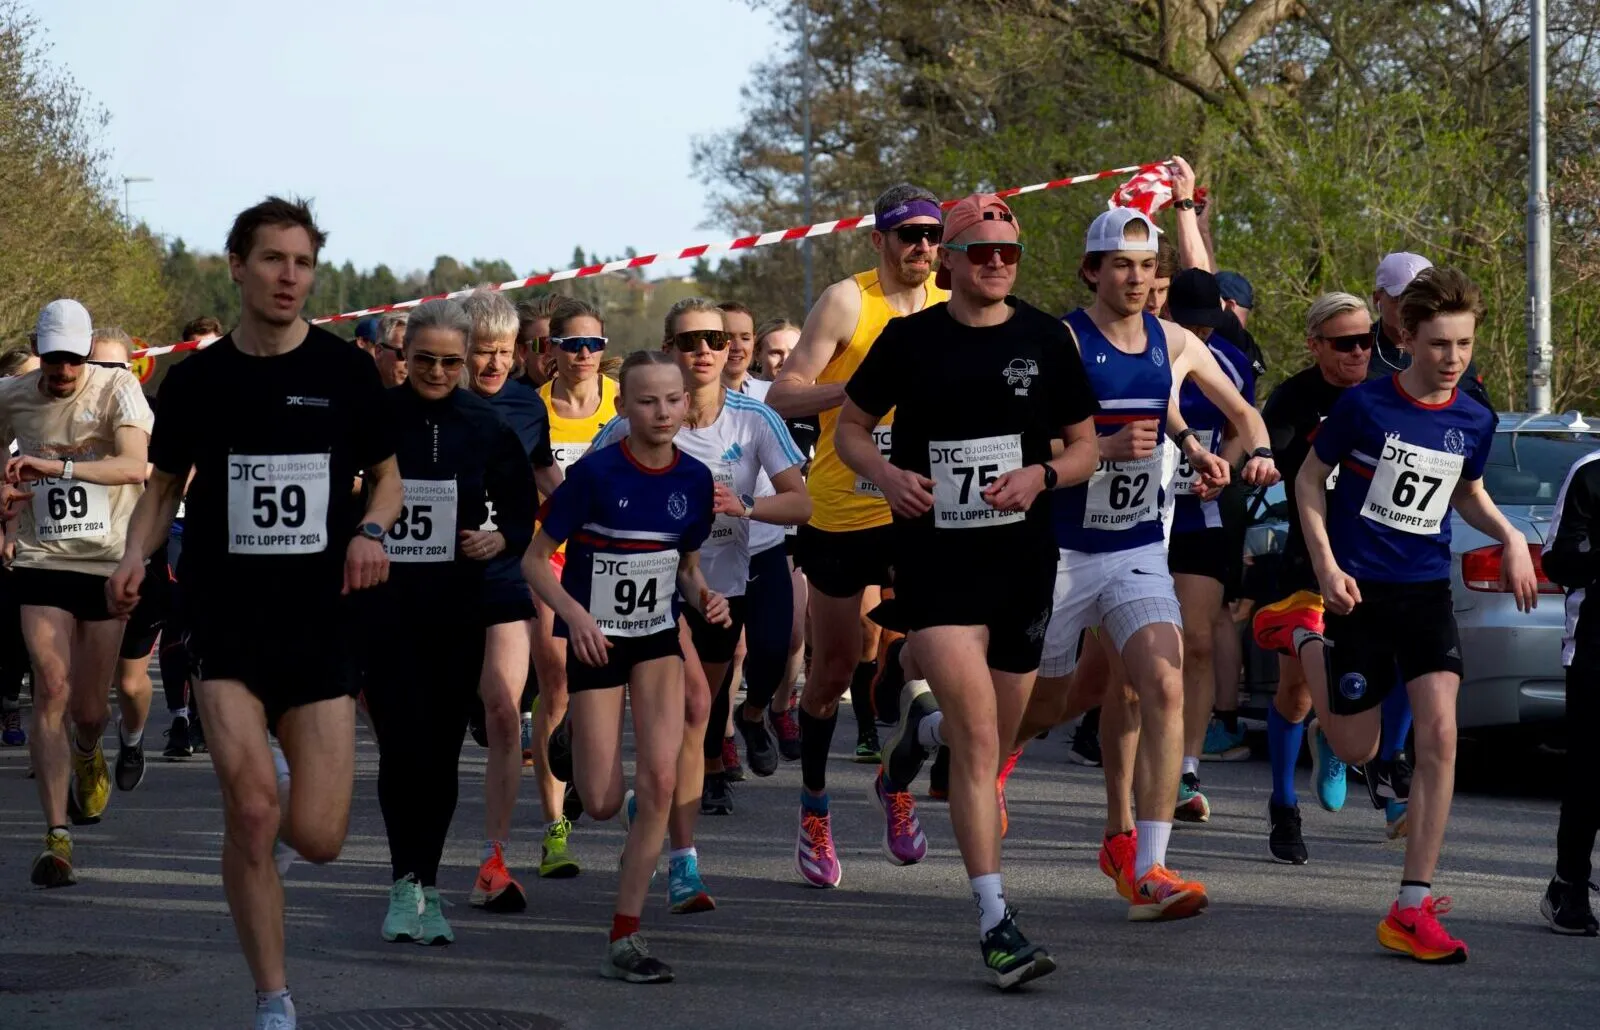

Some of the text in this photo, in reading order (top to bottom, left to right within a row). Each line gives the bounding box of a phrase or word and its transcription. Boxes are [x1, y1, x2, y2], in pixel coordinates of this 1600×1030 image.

[930, 442, 1019, 464] DTC DJURSHOLM
[1382, 445, 1418, 468] DTC
[230, 461, 328, 481] DTC DJURSHOLM
[952, 464, 999, 506] 75
[1109, 472, 1149, 510] 62
[1391, 470, 1443, 512] 67
[47, 485, 88, 521] 69
[252, 484, 306, 529] 59
[387, 504, 433, 541] 85
[941, 510, 959, 521] DTC
[960, 508, 996, 521] LOPPET
[1090, 513, 1109, 524] DTC
[1110, 511, 1138, 524] LOPPET
[1369, 502, 1389, 517] DTC
[1388, 509, 1423, 527] LOPPET
[54, 523, 82, 534] LOPPET
[84, 521, 104, 531] 2024
[712, 527, 733, 538] 2024
[235, 533, 321, 546] DTC LOPPET 2024
[390, 545, 424, 556] LOPPET
[425, 545, 448, 556] 2024
[594, 556, 679, 577] DTC DJURSHOLM
[614, 577, 658, 616] 94
[616, 618, 649, 630] LOPPET
[649, 614, 667, 627] 2024
